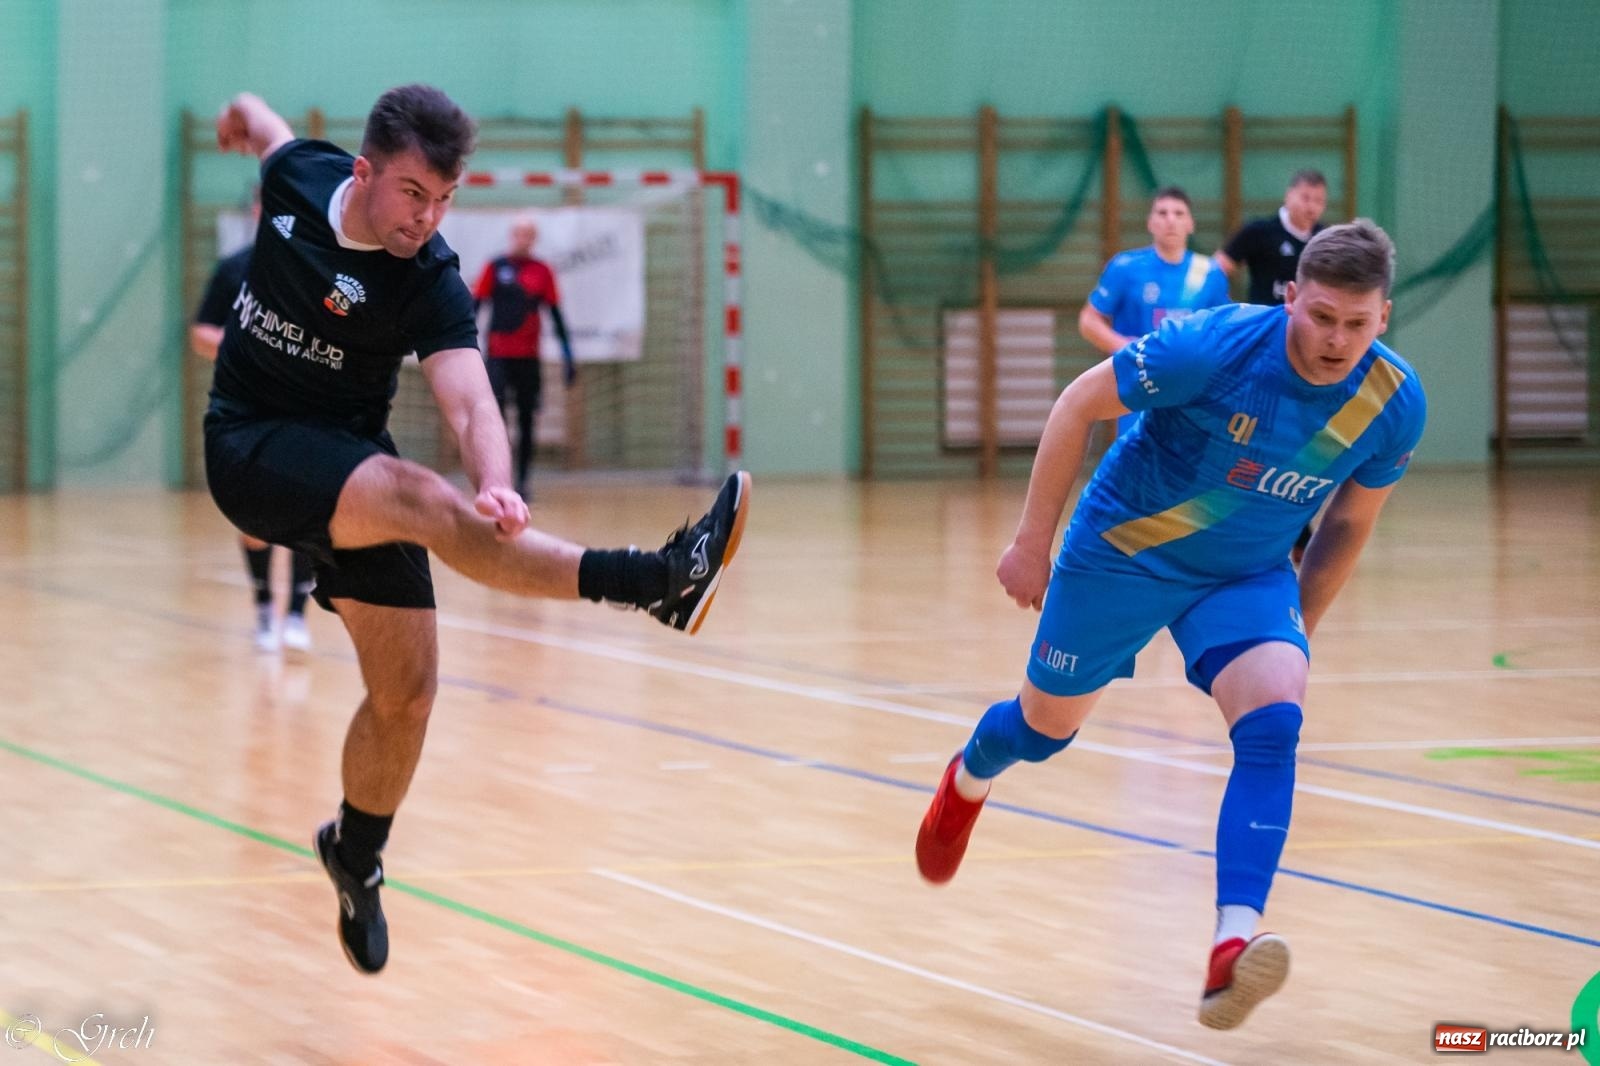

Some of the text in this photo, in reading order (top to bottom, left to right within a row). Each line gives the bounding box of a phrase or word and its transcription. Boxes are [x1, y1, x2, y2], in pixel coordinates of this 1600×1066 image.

[251, 325, 283, 351] PRACA
[287, 342, 302, 356] W
[1227, 412, 1259, 446] 91
[1256, 466, 1334, 500] LOFT
[1046, 645, 1079, 673] LOFT
